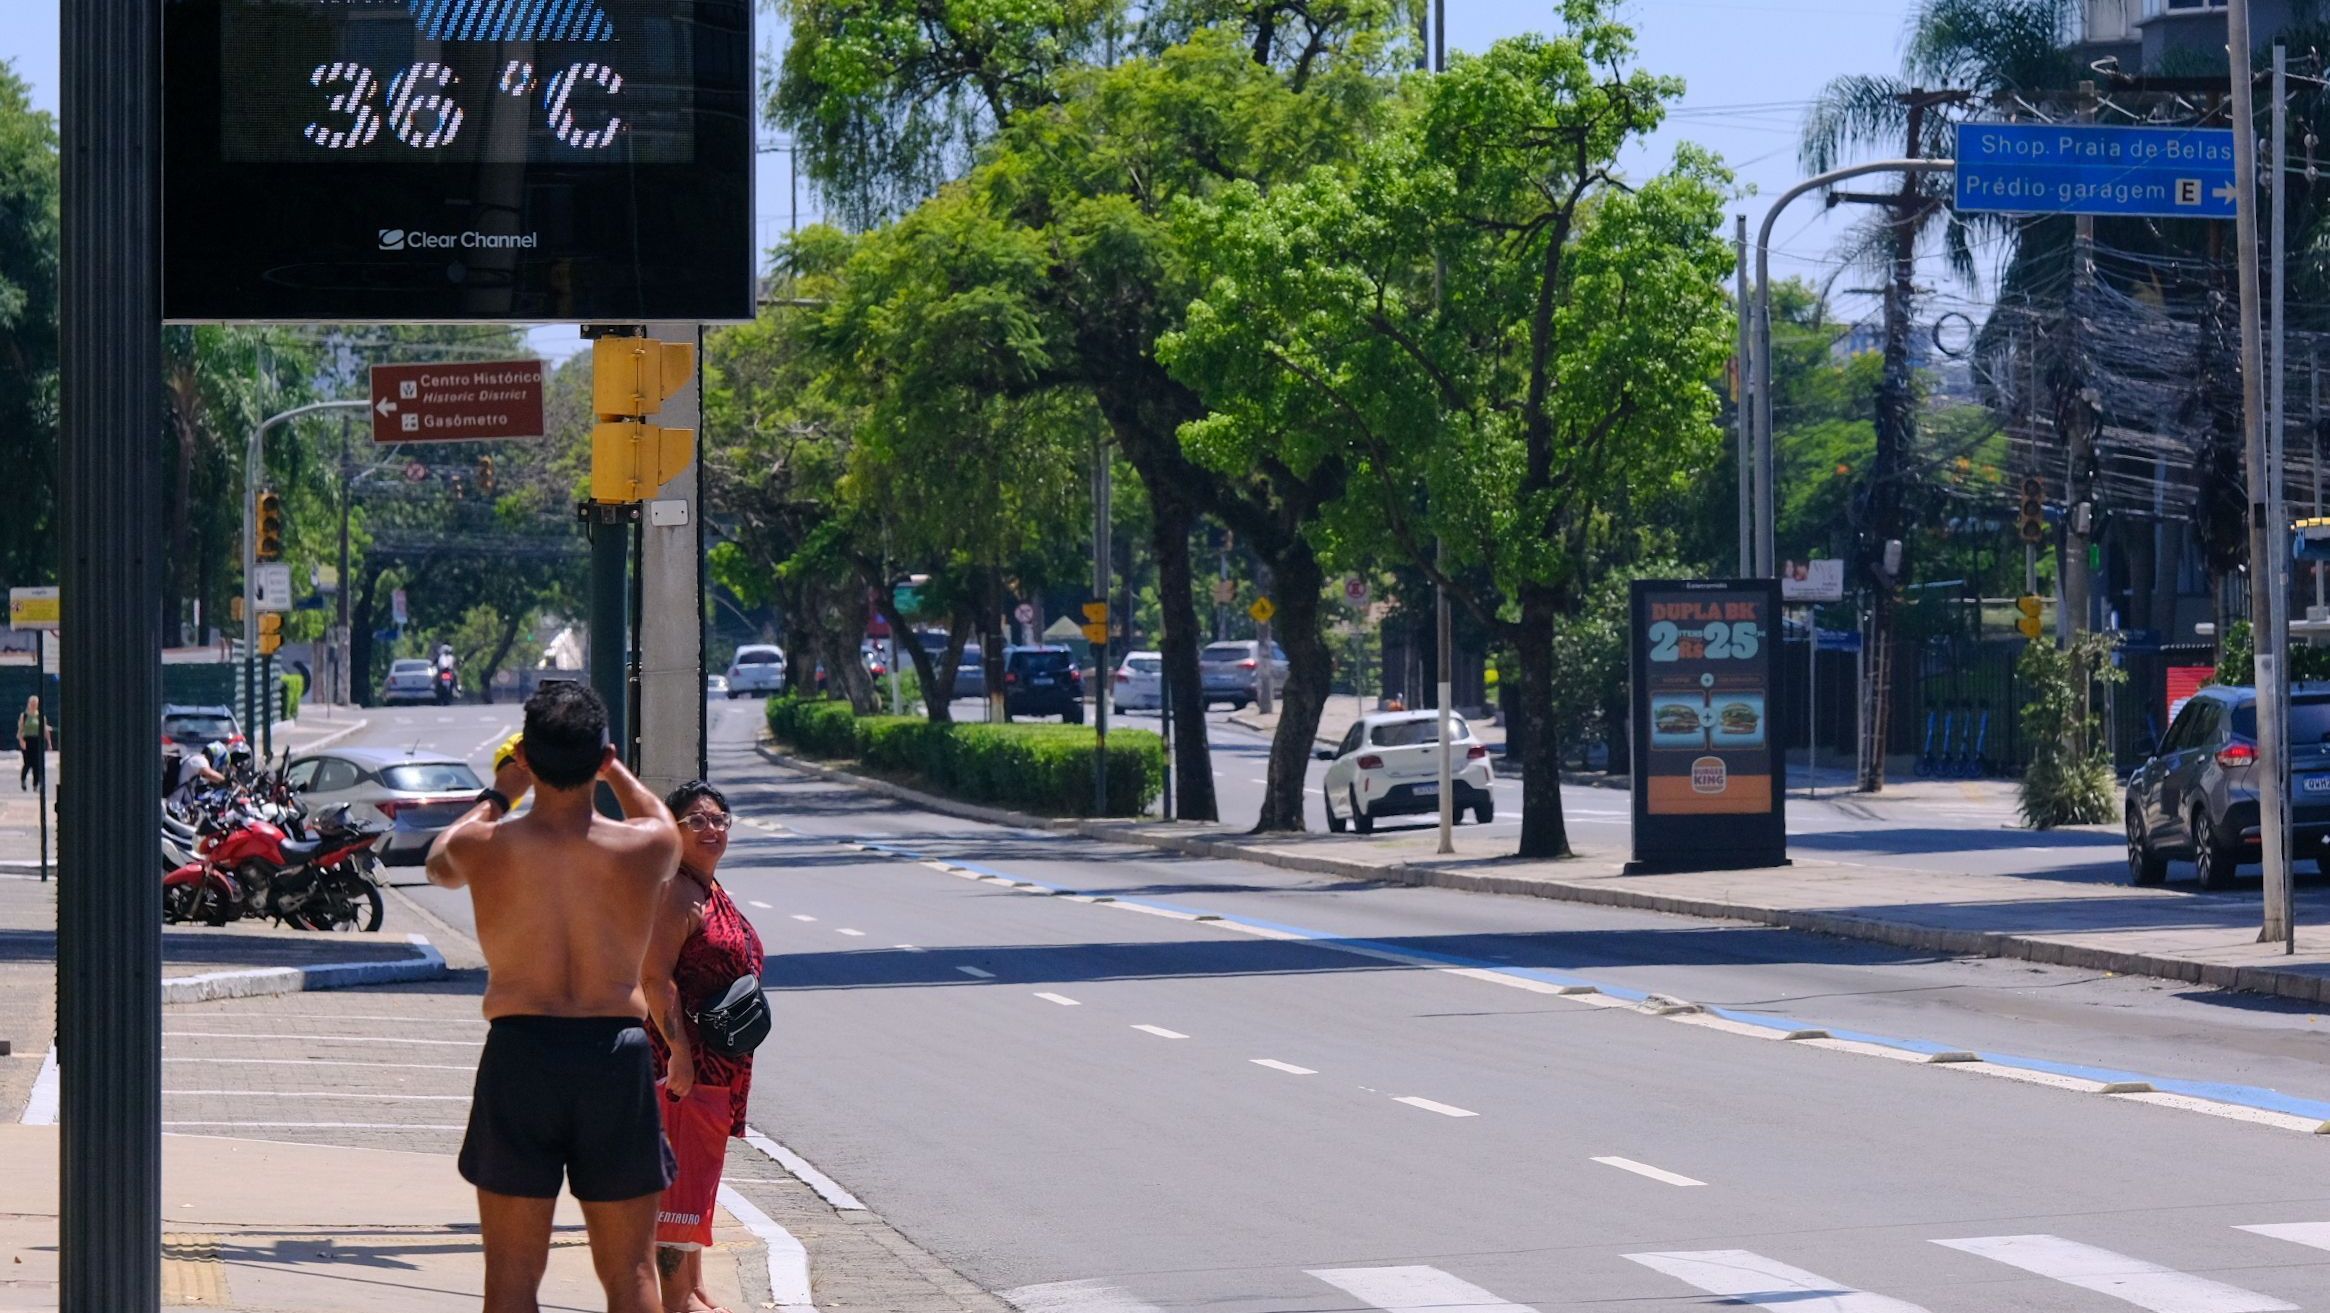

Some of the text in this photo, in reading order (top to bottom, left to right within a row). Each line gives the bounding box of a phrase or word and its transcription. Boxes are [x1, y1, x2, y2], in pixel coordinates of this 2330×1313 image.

[1981, 134, 2232, 160] Shop. Praia de Belas
[2182, 182, 2196, 202] E
[407, 231, 537, 249] Clear Channel
[420, 371, 541, 388] Centro Histórico
[423, 389, 527, 404] Historic District
[424, 413, 508, 428] Gasômetro
[1651, 601, 1758, 621] DUPLA BK
[1649, 620, 1679, 662] 2
[1704, 621, 1759, 660] 25
[1694, 775, 1724, 785] KING
[657, 1210, 700, 1225] ENTAURO
